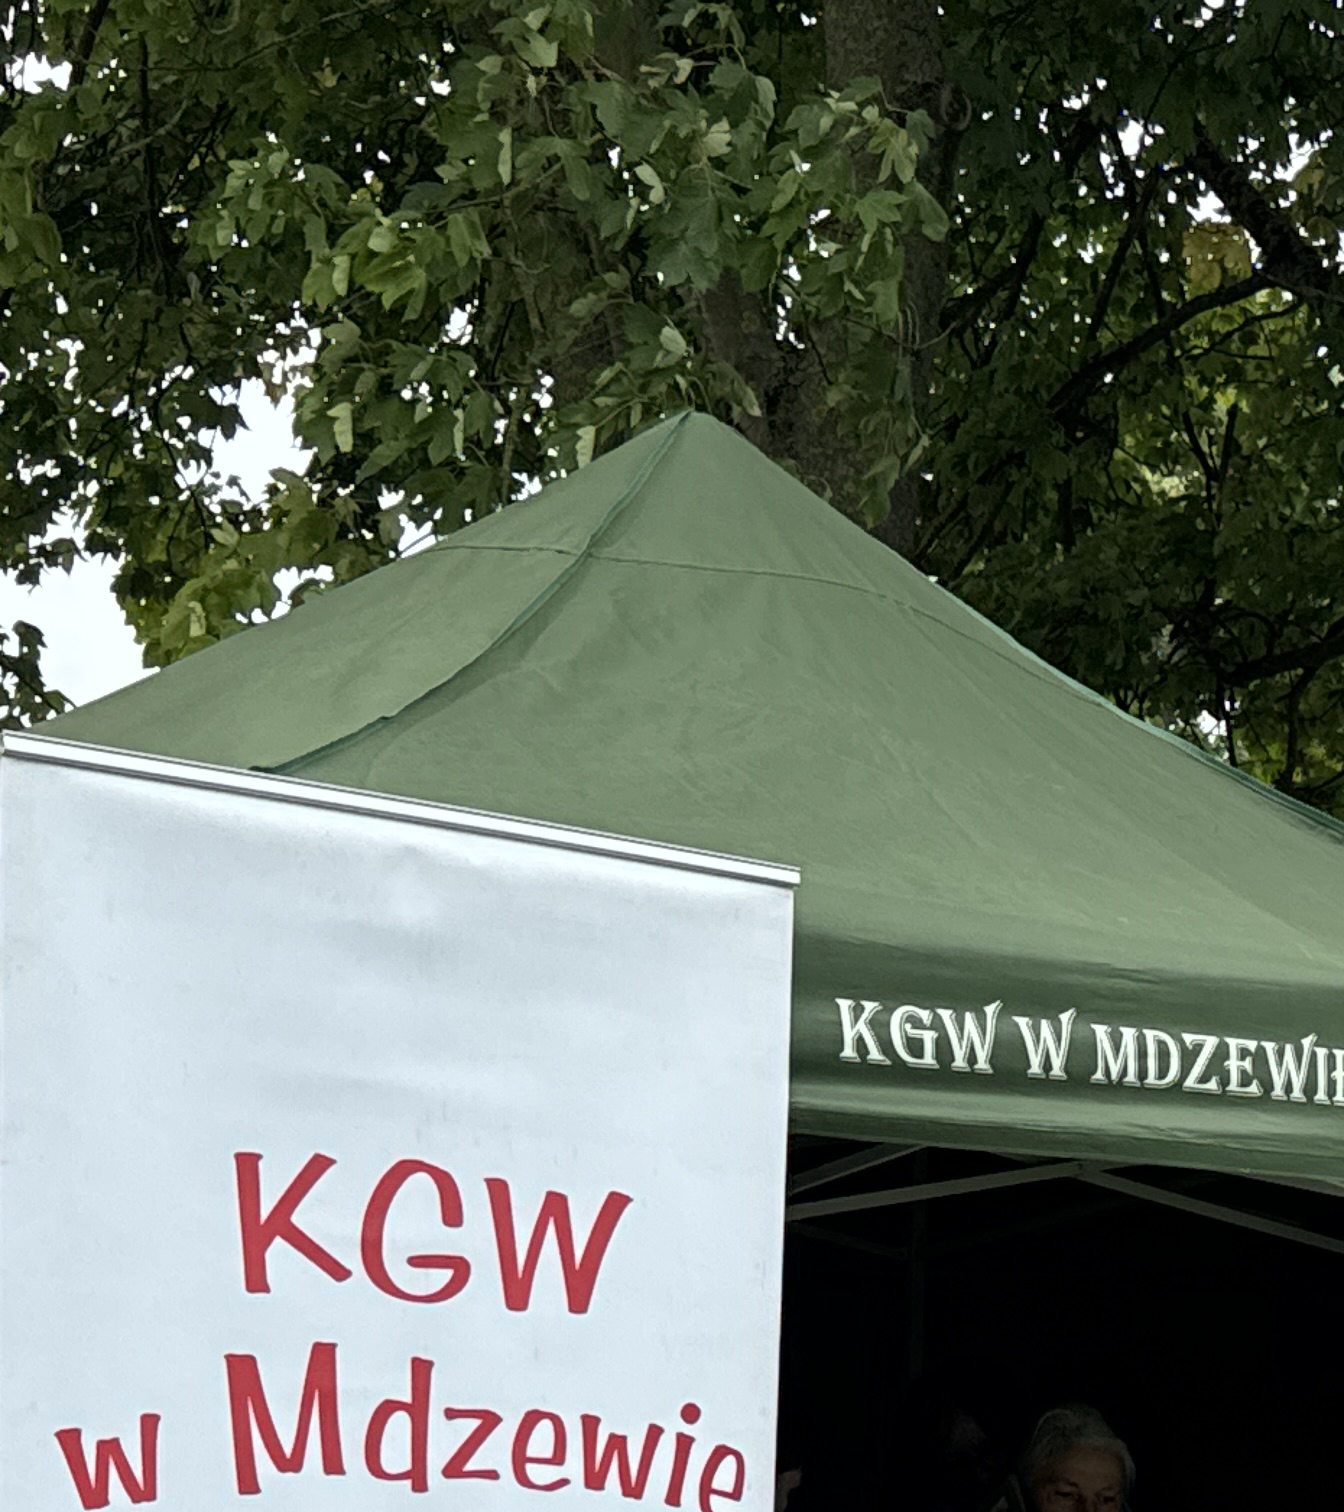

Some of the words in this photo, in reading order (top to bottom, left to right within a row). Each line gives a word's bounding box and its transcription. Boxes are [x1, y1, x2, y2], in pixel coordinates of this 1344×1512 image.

[834, 998, 1003, 1074] KGW
[1011, 1007, 1077, 1080] W
[234, 1151, 632, 1314] KGW
[54, 1412, 161, 1510] w
